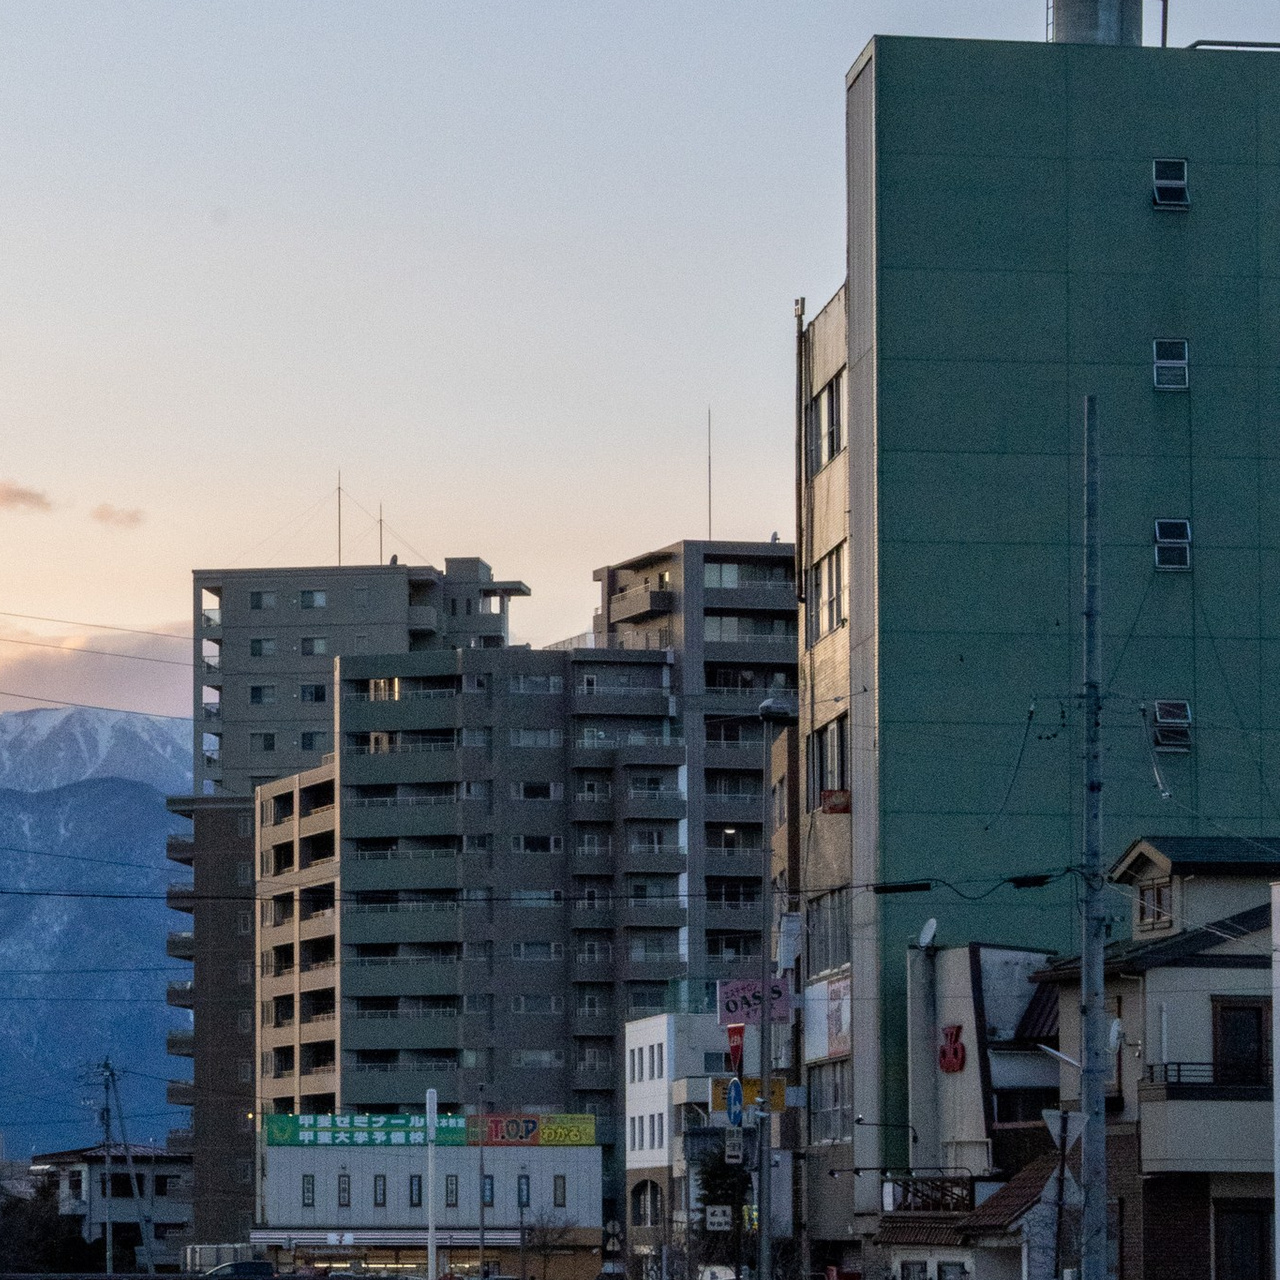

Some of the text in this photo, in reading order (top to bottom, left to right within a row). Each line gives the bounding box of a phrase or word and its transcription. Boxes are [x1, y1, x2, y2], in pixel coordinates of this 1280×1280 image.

[725, 985, 782, 1013] OASS
[298, 1115, 425, 1128] 甲斐ゼミナール
[489, 1118, 538, 1141] T.O.P
[298, 1131, 425, 1144] 甲斐大学予備校
